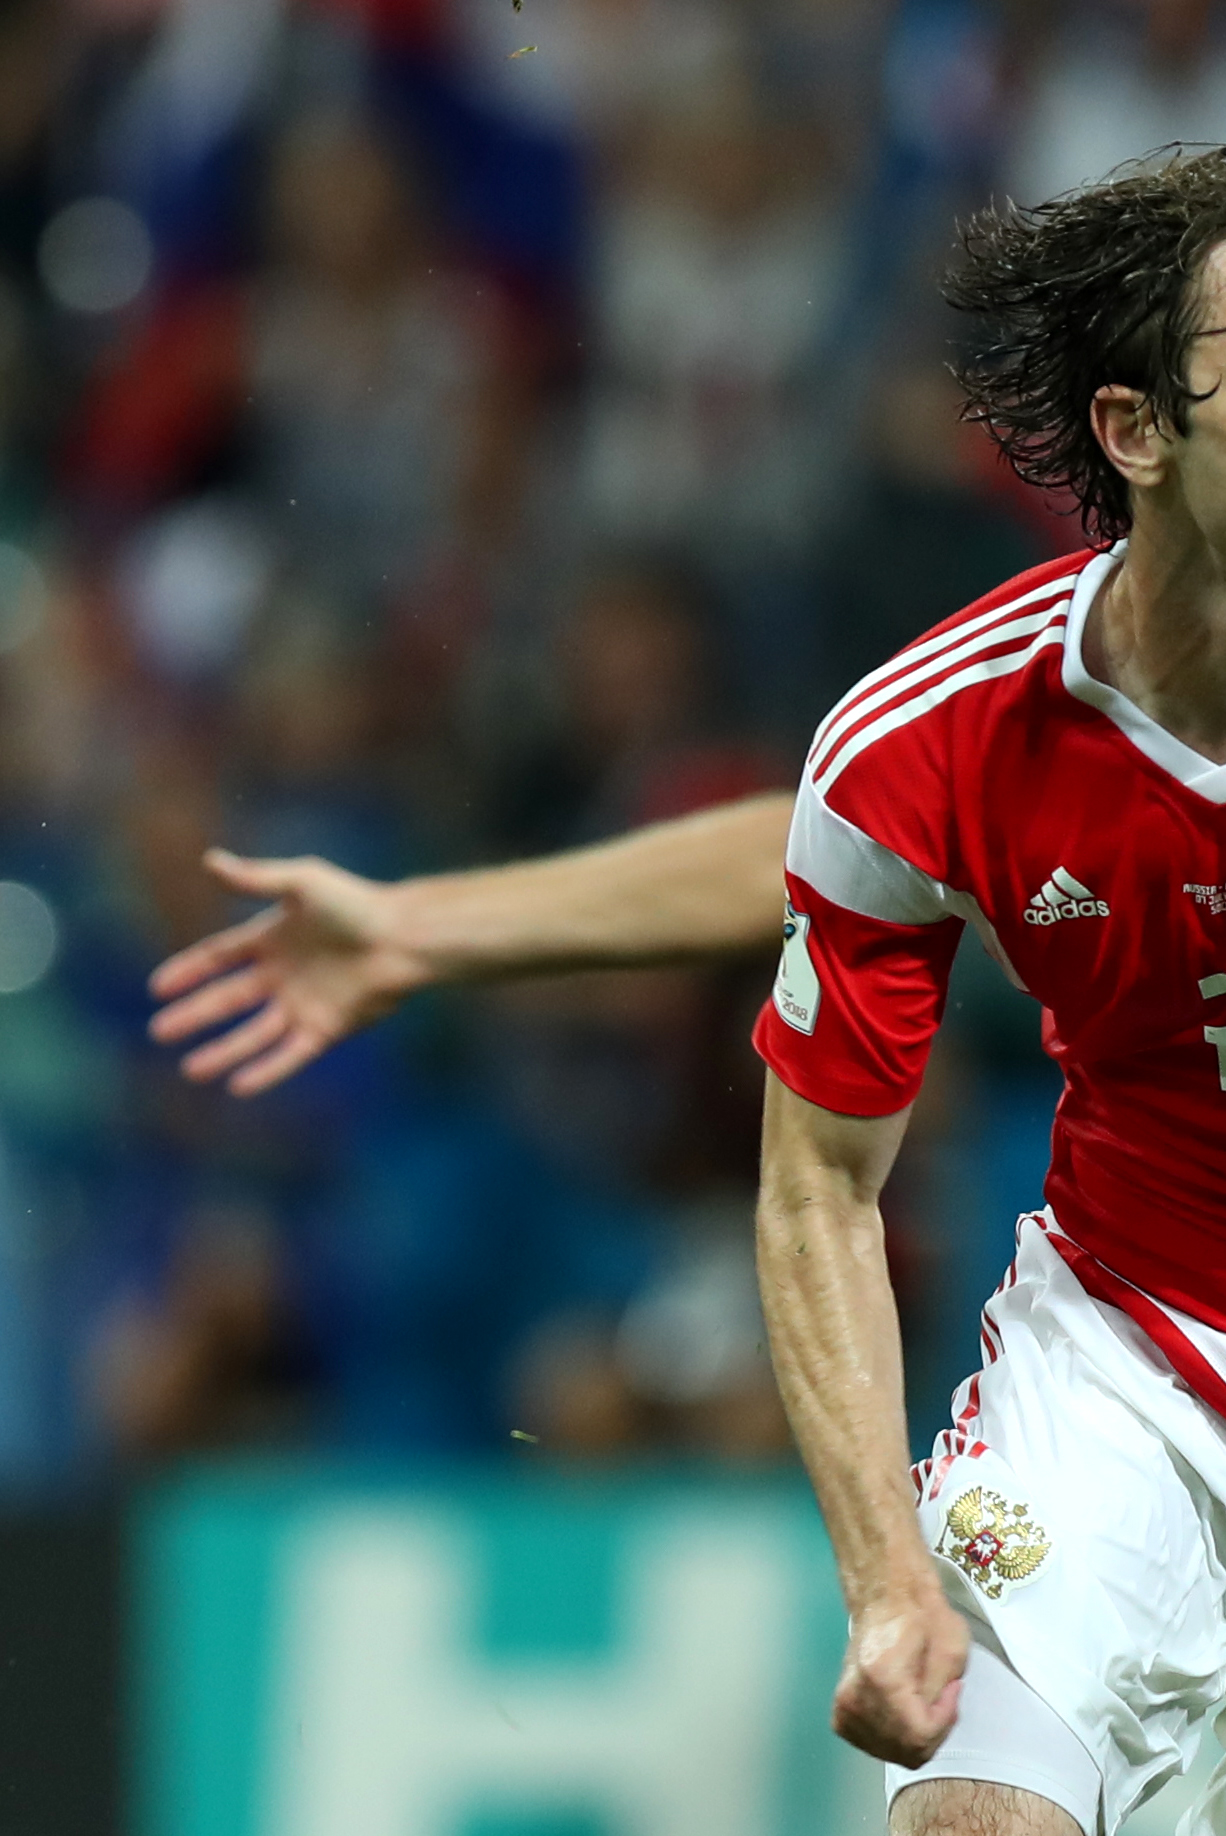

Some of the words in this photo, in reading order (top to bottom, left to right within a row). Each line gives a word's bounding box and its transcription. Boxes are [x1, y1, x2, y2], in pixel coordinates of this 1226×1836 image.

[1183, 883, 1217, 895] RUSSIA
[1023, 899, 1111, 926] adidas
[783, 997, 808, 1021] 2018
